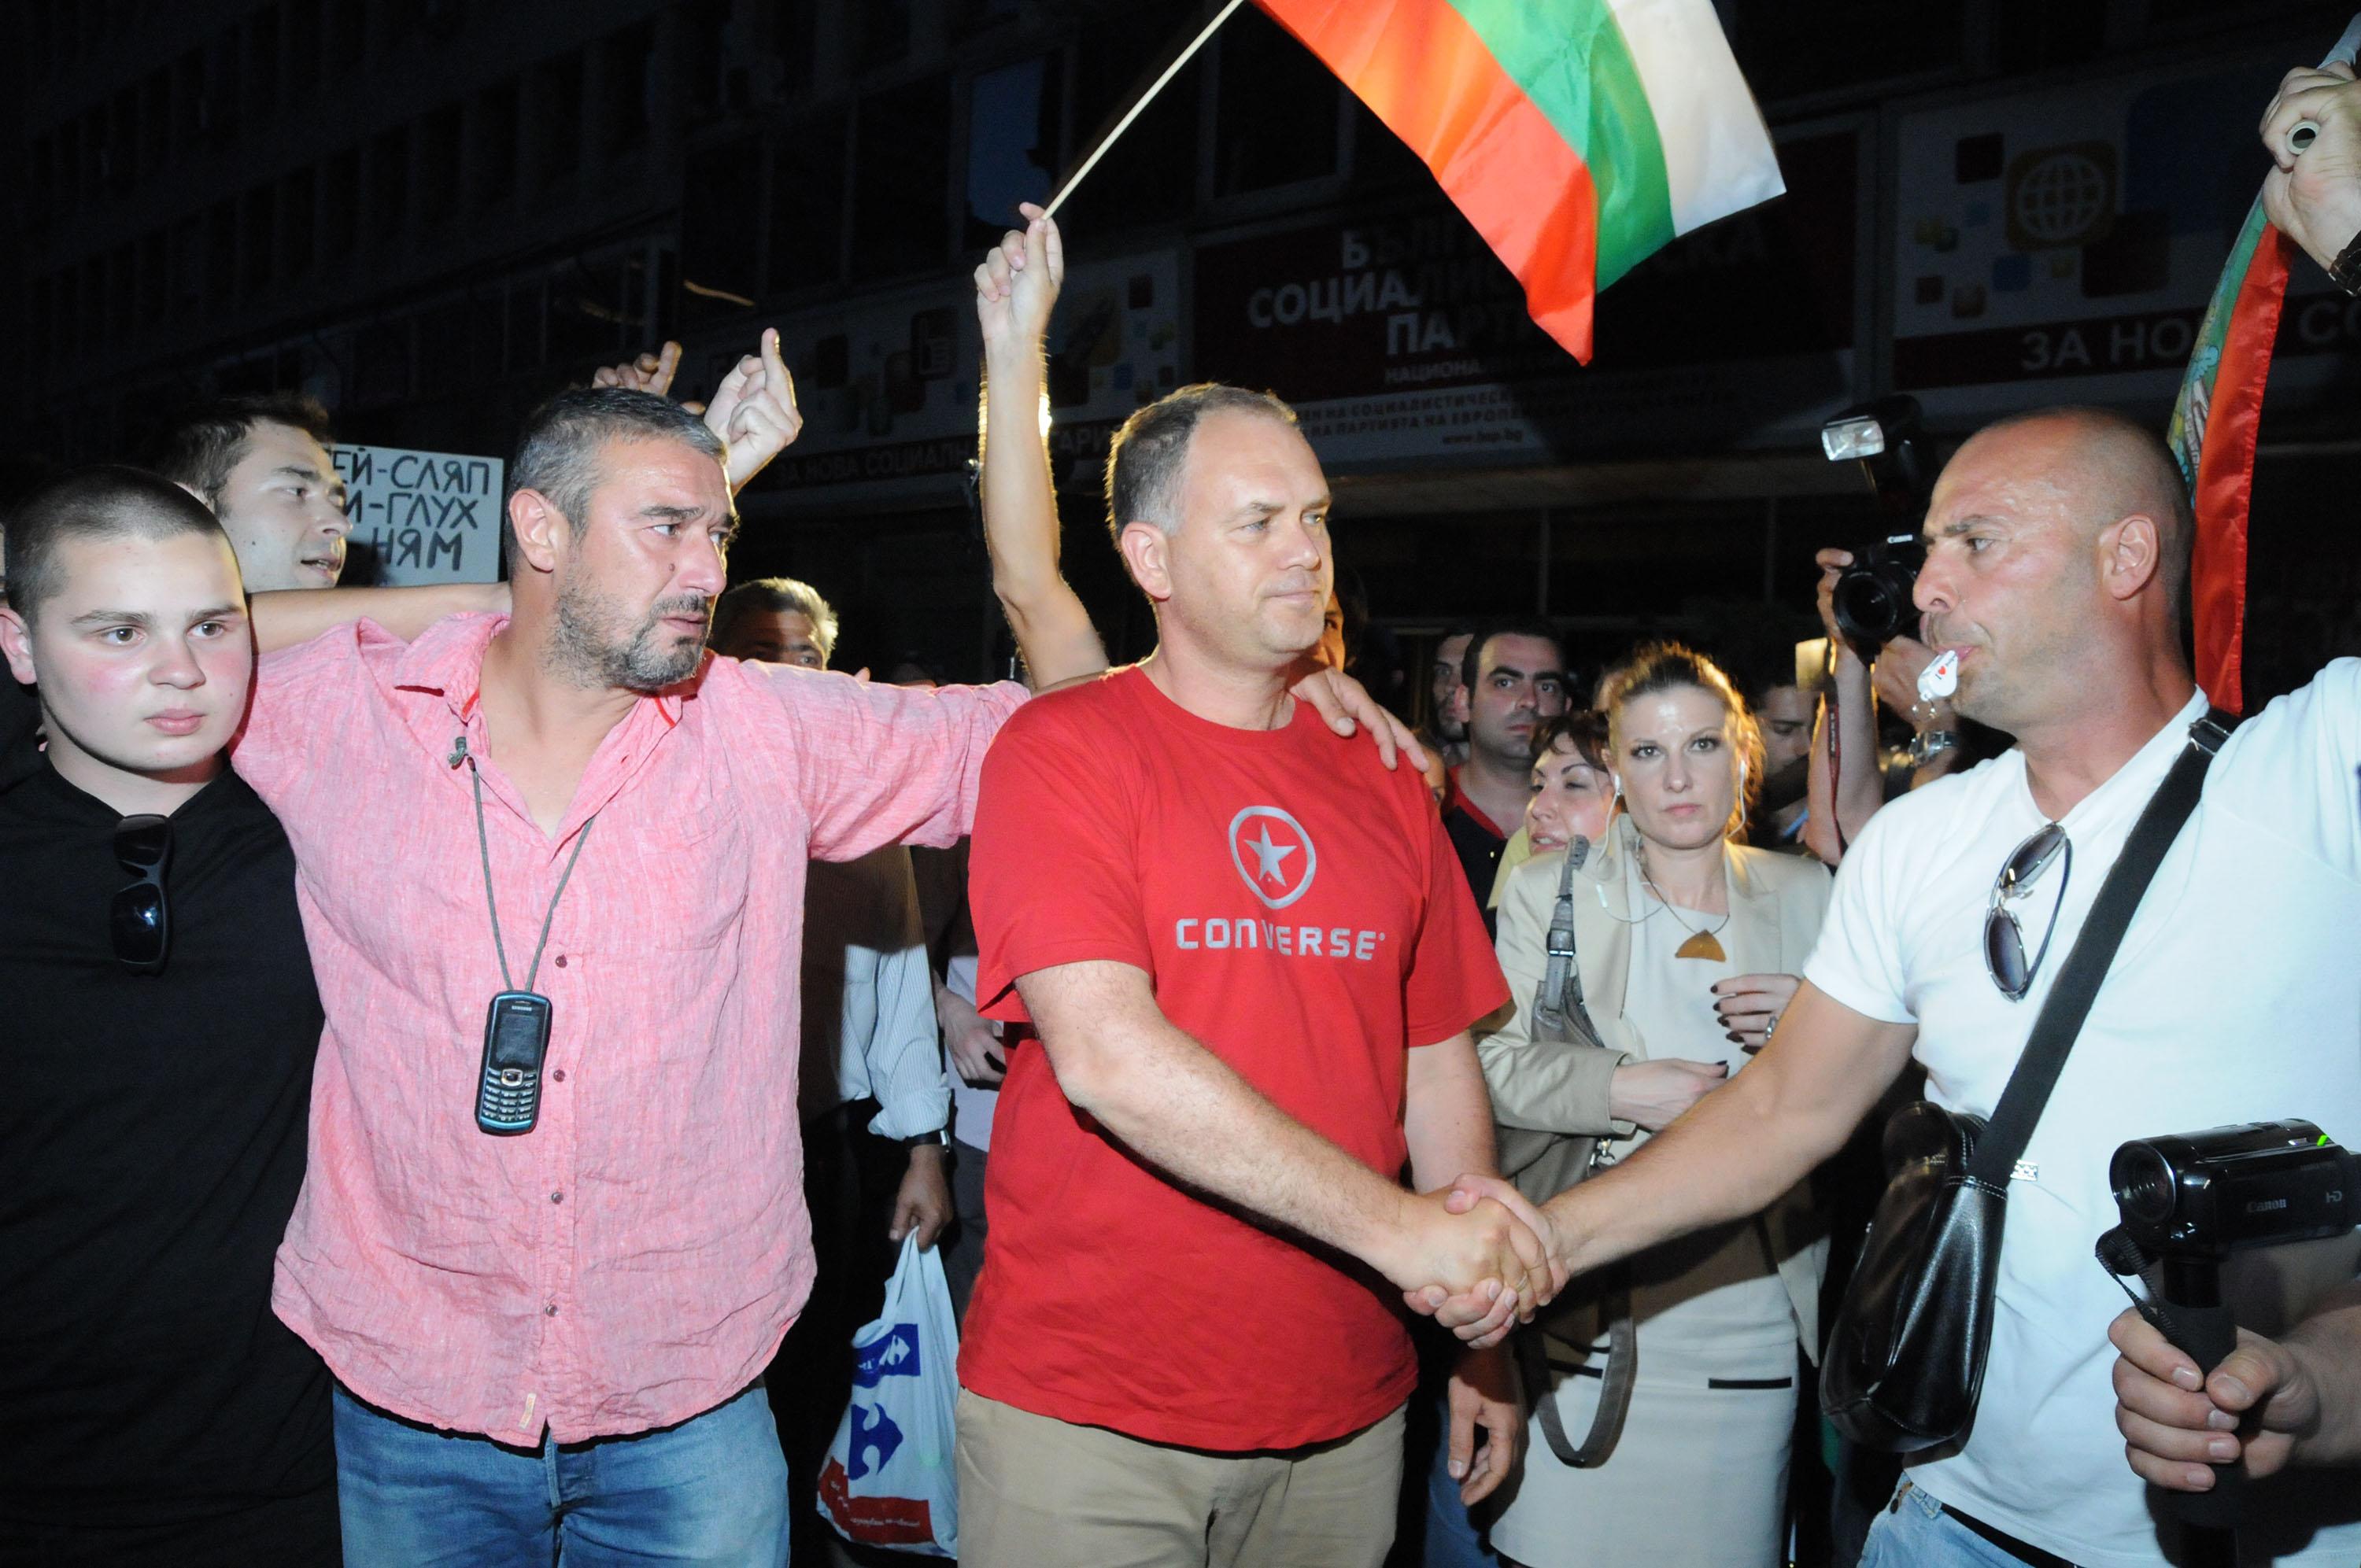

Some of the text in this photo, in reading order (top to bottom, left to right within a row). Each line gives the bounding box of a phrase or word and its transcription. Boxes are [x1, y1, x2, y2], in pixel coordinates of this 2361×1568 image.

[2020, 328, 2092, 372] ЗА
[2108, 315, 2202, 366] НО
[865, 437, 972, 478] СОЦИАЛН
[1175, 917, 1377, 961] CONVERSE
[2245, 1197, 2287, 1213] Canon
[2324, 1189, 2343, 1204] HD
